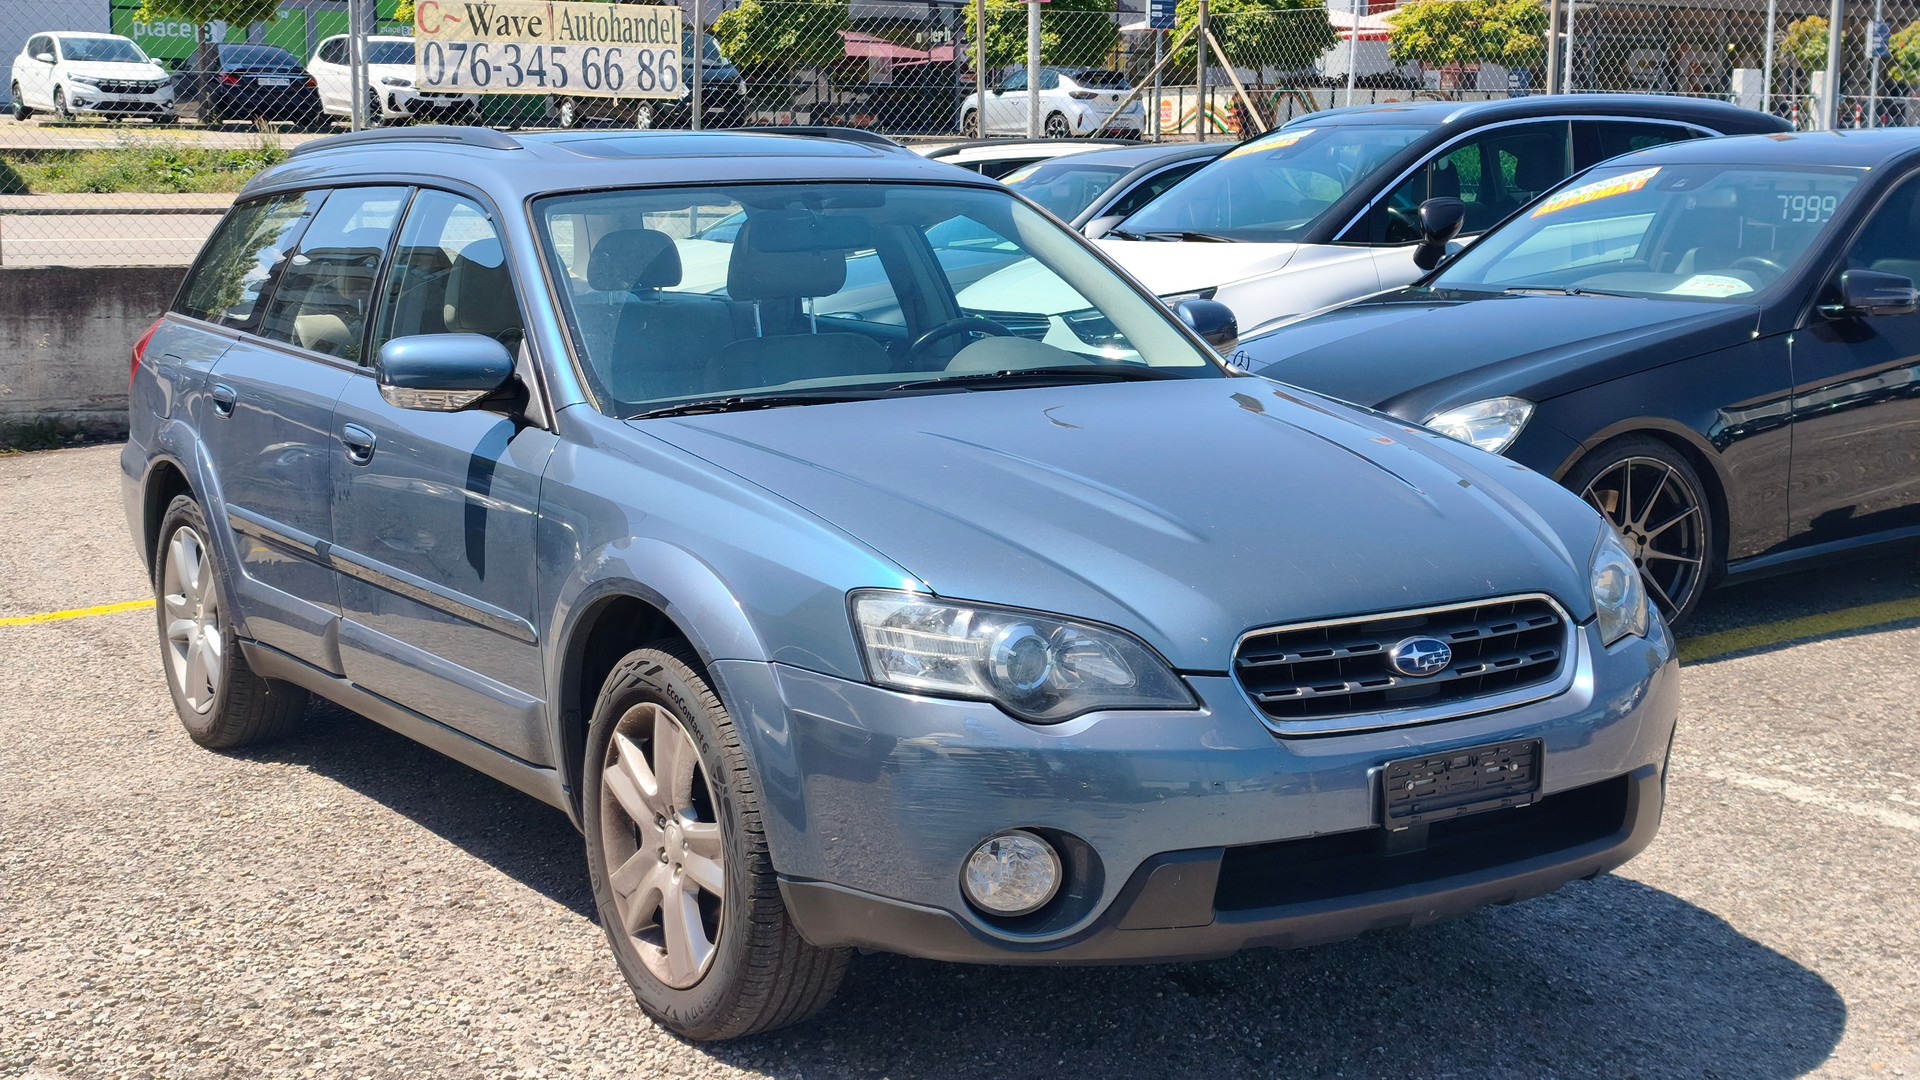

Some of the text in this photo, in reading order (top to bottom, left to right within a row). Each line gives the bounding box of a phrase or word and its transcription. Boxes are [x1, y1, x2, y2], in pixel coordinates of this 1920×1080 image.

[559, 7, 678, 44] Autohandel
[423, 41, 678, 92] 076-345 66 86
[666, 683, 704, 742] EcoContact
